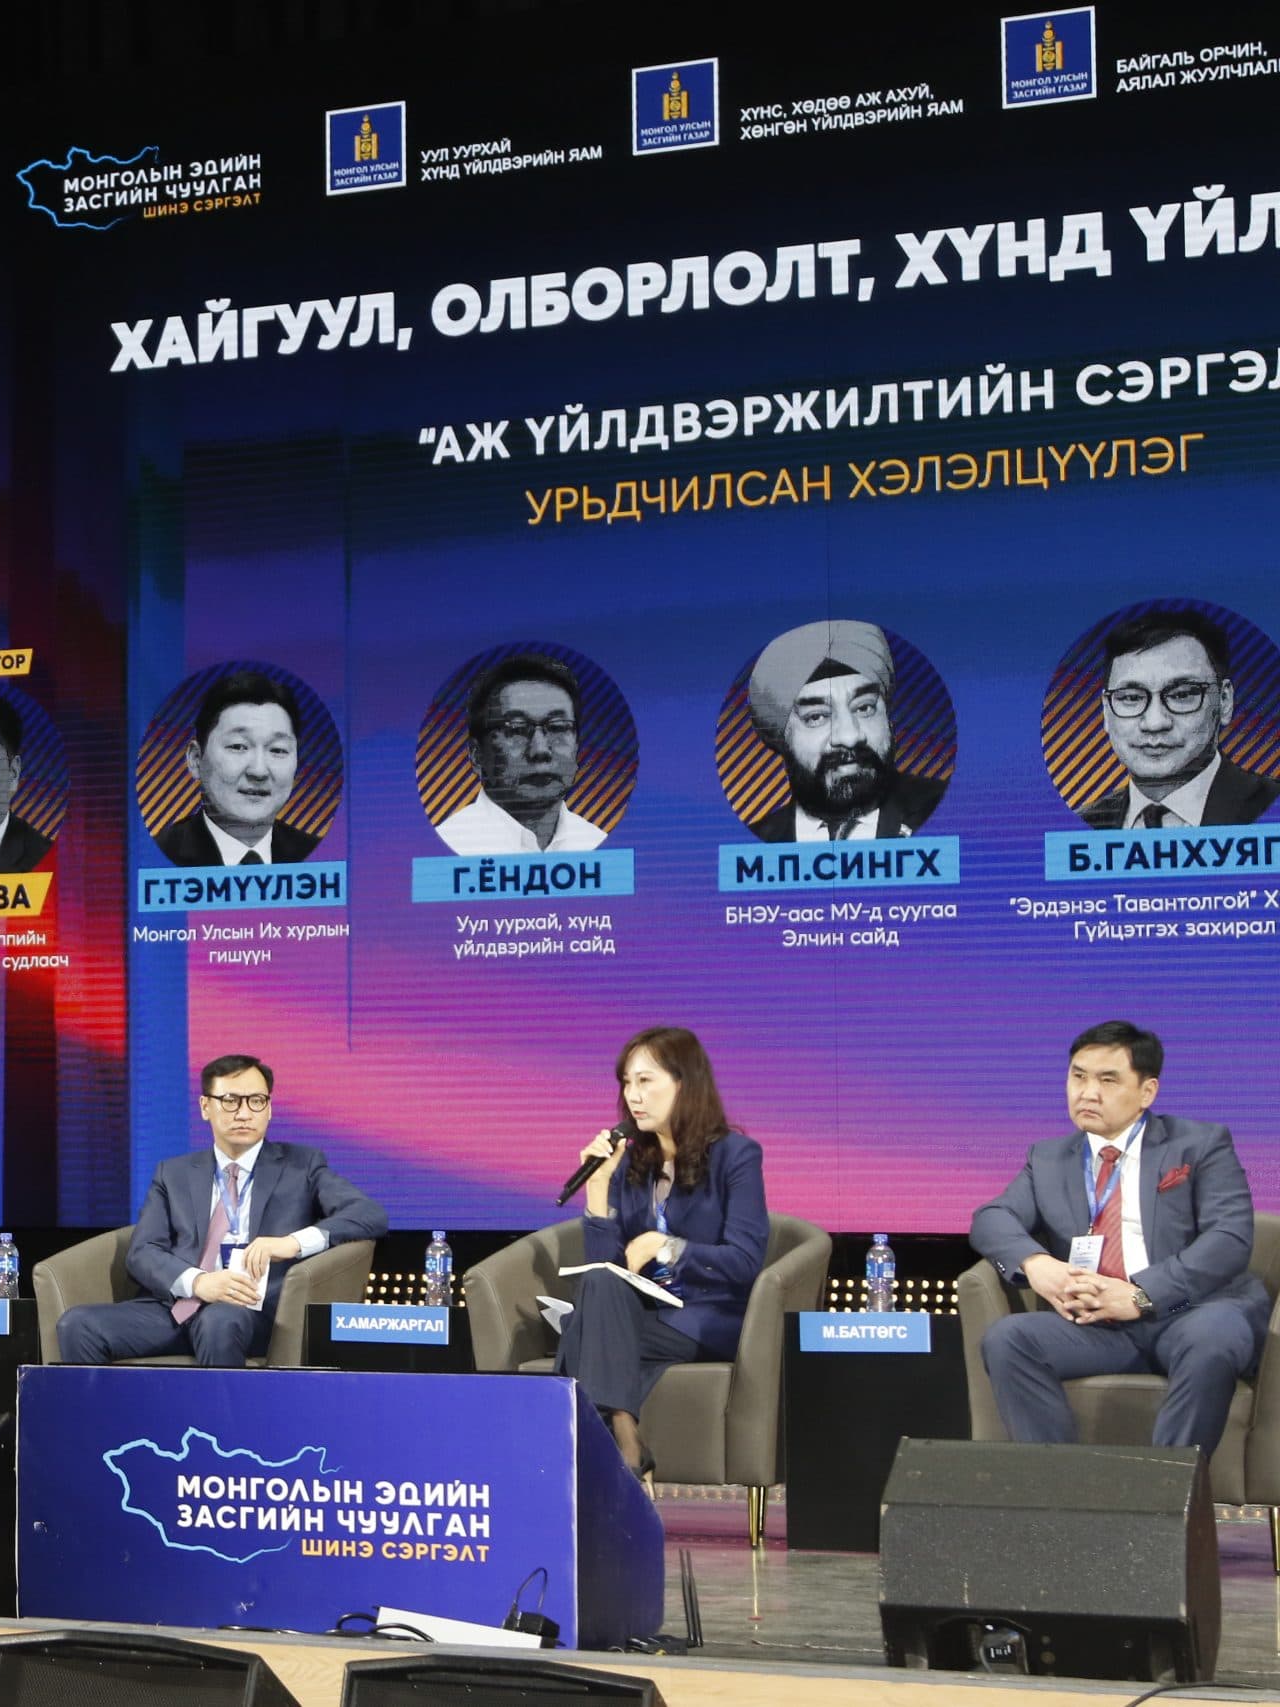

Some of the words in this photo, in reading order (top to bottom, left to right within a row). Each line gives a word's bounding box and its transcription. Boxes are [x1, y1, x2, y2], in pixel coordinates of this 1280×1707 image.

[1117, 52, 1194, 74] БАЙГАЛЬ
[1200, 42, 1267, 62] ОРЧИН,
[1011, 77, 1051, 88] МОНГОЛ
[1053, 72, 1088, 83] УЛСЫН
[1117, 71, 1175, 93] АЯЛАЛ
[1180, 58, 1280, 84] ЖУУЛЧЛАЛ
[740, 103, 786, 121] ХҮНС,
[792, 95, 851, 115] ХӨДӨӨ
[856, 92, 882, 108] АЖ
[886, 83, 934, 103] АХУЙ,
[1013, 86, 1055, 98] ЗАСГИЙН
[1058, 83, 1087, 93] ГАЗАР
[641, 124, 677, 136] МОНГОЛ
[680, 120, 711, 131] УЛСЫН
[740, 118, 807, 140] ХӨНГӨН
[812, 103, 921, 131] ҮЙЛДВЭРИЙН
[927, 99, 964, 117] ЯАМ
[420, 148, 449, 164] УУЛ
[453, 138, 511, 160] УУРХАЙ
[643, 134, 681, 146] ЗАСГИЙН
[683, 131, 710, 140] ГАЗАР
[64, 165, 182, 193] МОНГОЛЫН
[189, 154, 261, 178] ЭДИЙН
[334, 166, 368, 176] МОНГОЛ
[370, 162, 399, 172] УЛСЫН
[421, 163, 460, 181] ХҮНД
[464, 149, 564, 176] ҮЙЛДВЭРИЙН
[569, 146, 602, 162] ЯАМ
[336, 174, 372, 185] ЗАСГИЙН
[373, 172, 398, 180] ГАЗАР
[64, 185, 158, 212] ЗАСГИЙН
[166, 173, 261, 199] ЧУУЛГАН
[143, 202, 188, 218] ШИНЭ
[194, 193, 261, 213] СЭРГЭЛТ
[110, 292, 412, 373] ХАЙГУУЛ,
[431, 239, 875, 337] ОЛБОРЛОЛТ,
[895, 211, 1111, 288] ХҮНД
[1129, 183, 1280, 262] ҮЙЛ
[525, 363, 1054, 456] ҮЙЛДВЭРЖИЛТИЙН
[525, 465, 830, 525] УРЬДЧИЛСАН
[849, 433, 1205, 499] ХЭЛЭЛЦҮҮЛЭГ
[736, 848, 941, 883] М.П.СИНГХ
[1069, 836, 1280, 872] Б.ГАНХУЯГ
[144, 872, 340, 904] Г.ТЭМҮҮЛЭН
[453, 859, 601, 895] Г.ЁНДОН
[456, 915, 488, 935] Уул
[495, 913, 562, 934] уурхай,
[568, 915, 612, 931] хүнд
[726, 905, 824, 924] БНЭУ-аас
[831, 903, 883, 922] МУ-д
[889, 904, 957, 922] суугаа
[134, 926, 196, 942] Монгол
[202, 924, 253, 940] Улсын
[260, 923, 281, 938] Их
[287, 923, 349, 940] хурлын
[782, 929, 843, 947] Элчин
[851, 928, 899, 946] сайд
[1074, 921, 1178, 943] Гүйцэтгэх
[1185, 919, 1275, 938] захирал
[209, 949, 271, 965] гишүүн
[453, 938, 563, 959] үйлдвэрийн
[570, 936, 615, 954] сайд
[2, 955, 69, 969] судлаач
[336, 1316, 443, 1332] Х.АМАРЖАРГАЛ
[822, 1325, 908, 1339] М.БАТТӨГС
[177, 1475, 363, 1504] МОНГОЛЫН
[376, 1478, 490, 1508] ЭДИЙН
[177, 1503, 323, 1533] ЗАСГИЙН
[337, 1508, 490, 1538] ЧУУЛГАН
[301, 1538, 373, 1557] ШИНЭ
[382, 1542, 489, 1563] СЭРГЭЛТ
